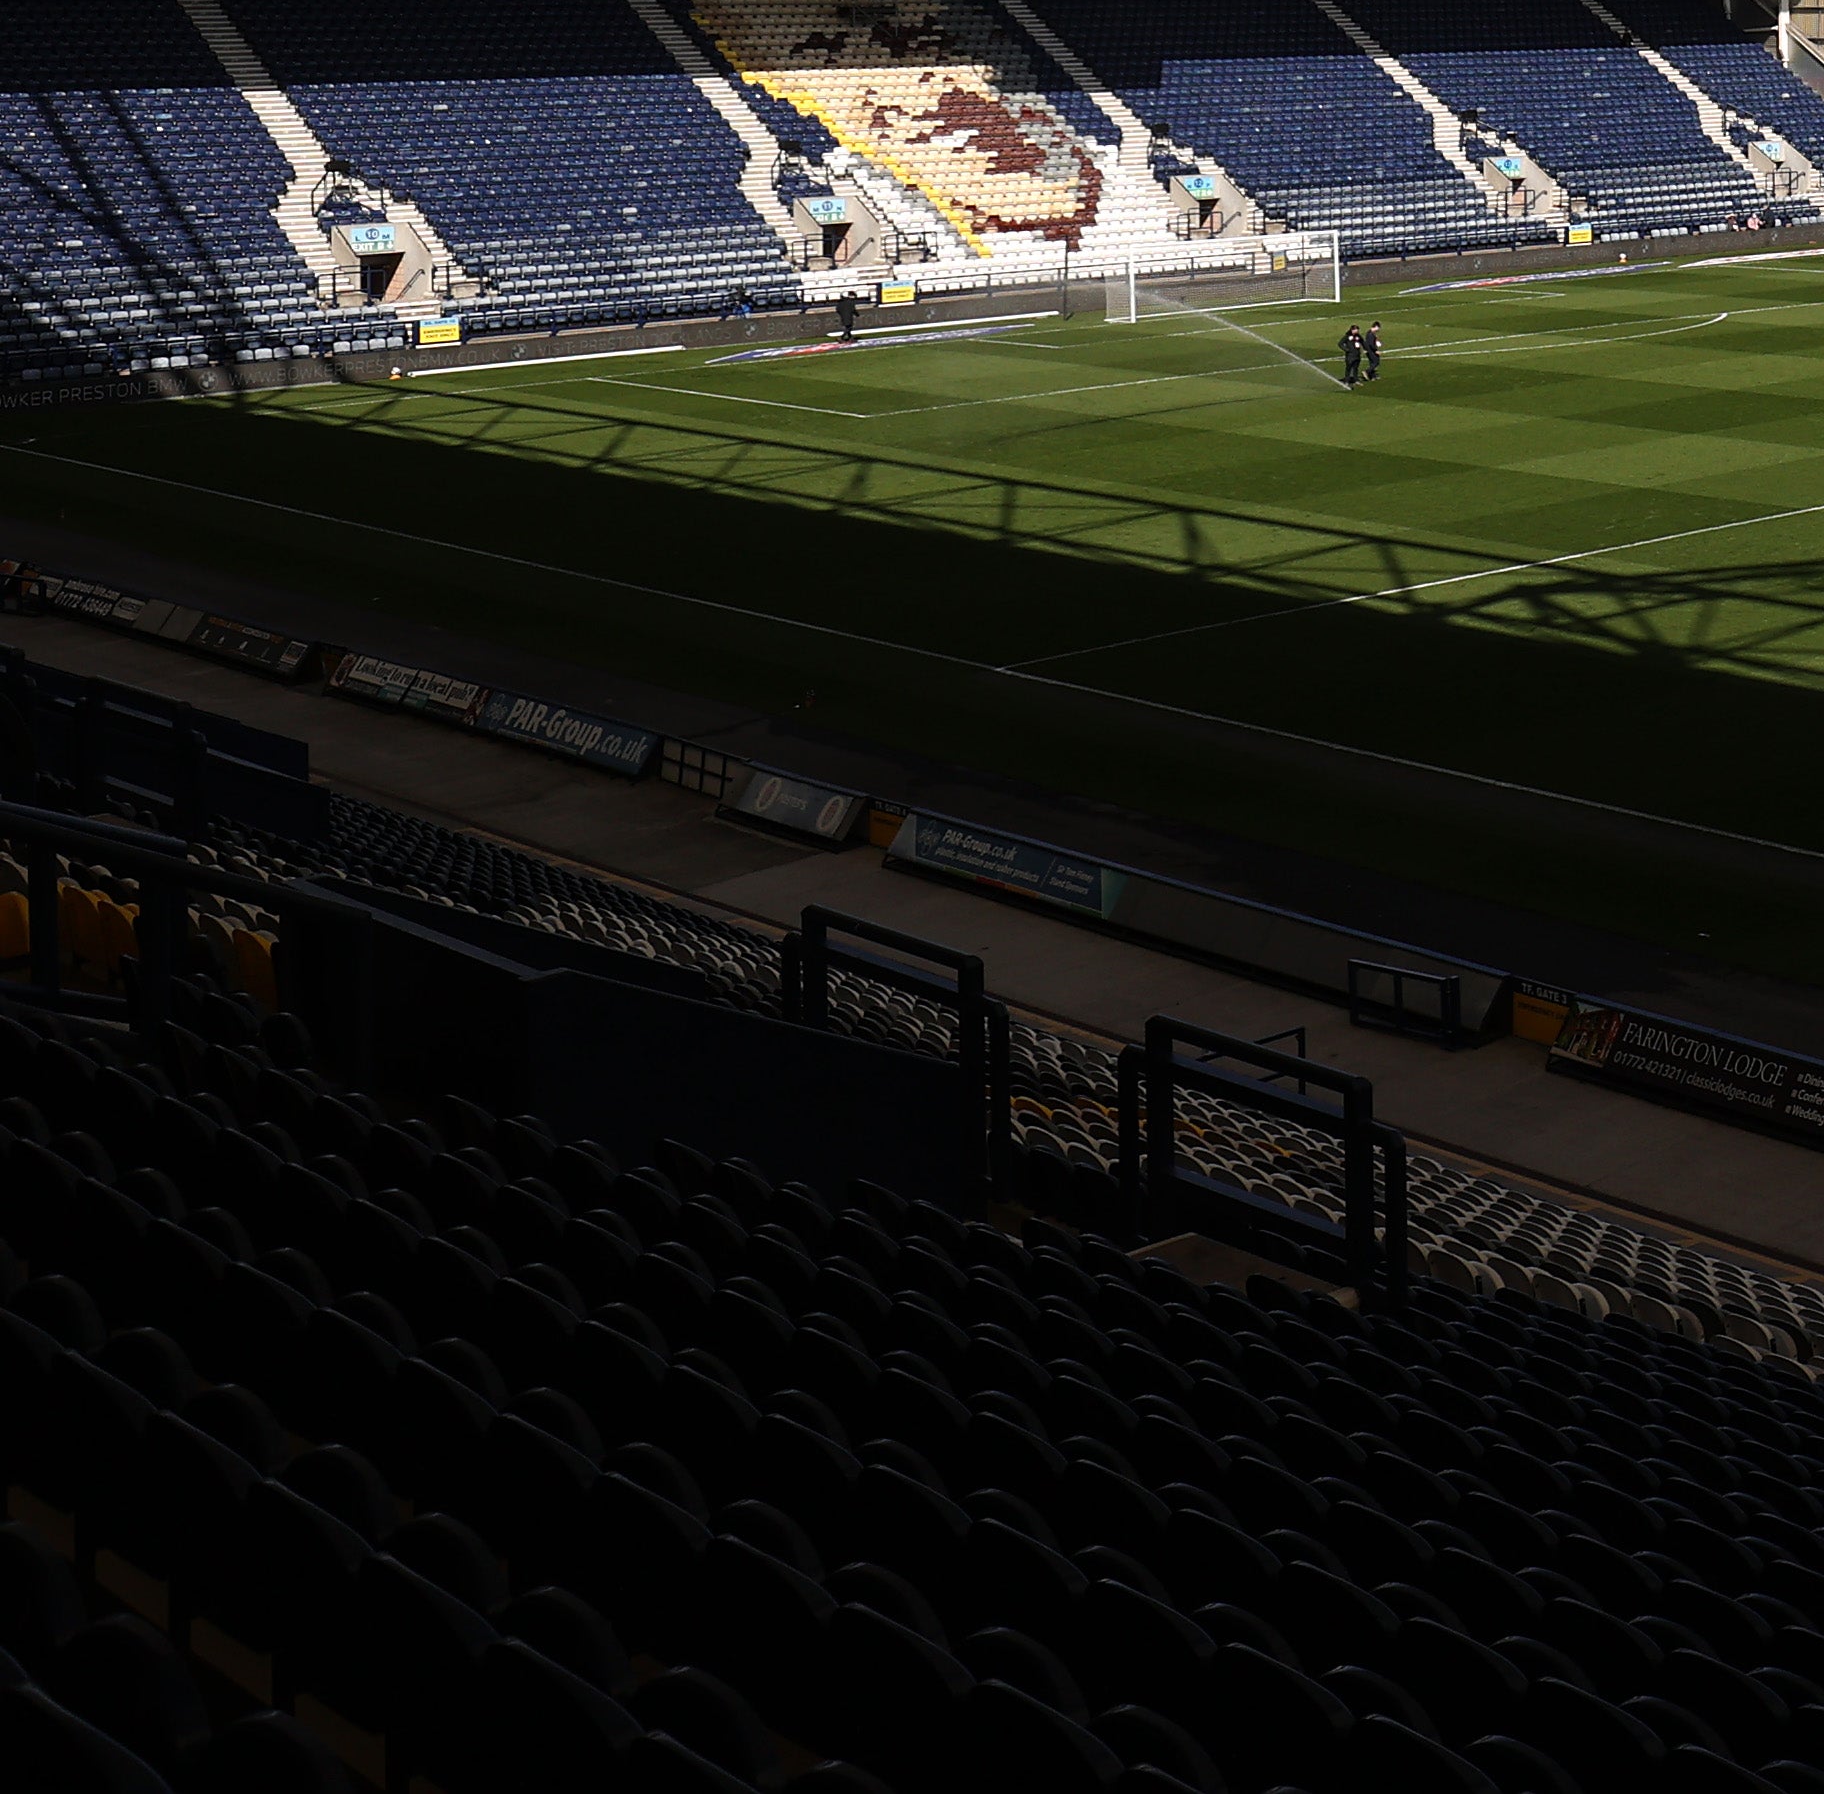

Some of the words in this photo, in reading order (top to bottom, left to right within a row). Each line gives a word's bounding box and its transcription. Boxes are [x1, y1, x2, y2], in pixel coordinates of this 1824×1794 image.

[59, 381, 141, 403] PRESTON
[147, 376, 188, 395] BMW
[506, 696, 649, 763] PAR-Group.co.uk
[942, 828, 1018, 861] PAR-Group.co.uk
[1521, 983, 1535, 995] TF.
[1535, 985, 1558, 1002] GATE
[1622, 1021, 1722, 1069] FARINGTON
[1723, 1049, 1787, 1087] LODGE
[1685, 1070, 1775, 1109] classiclodges.co.uk
